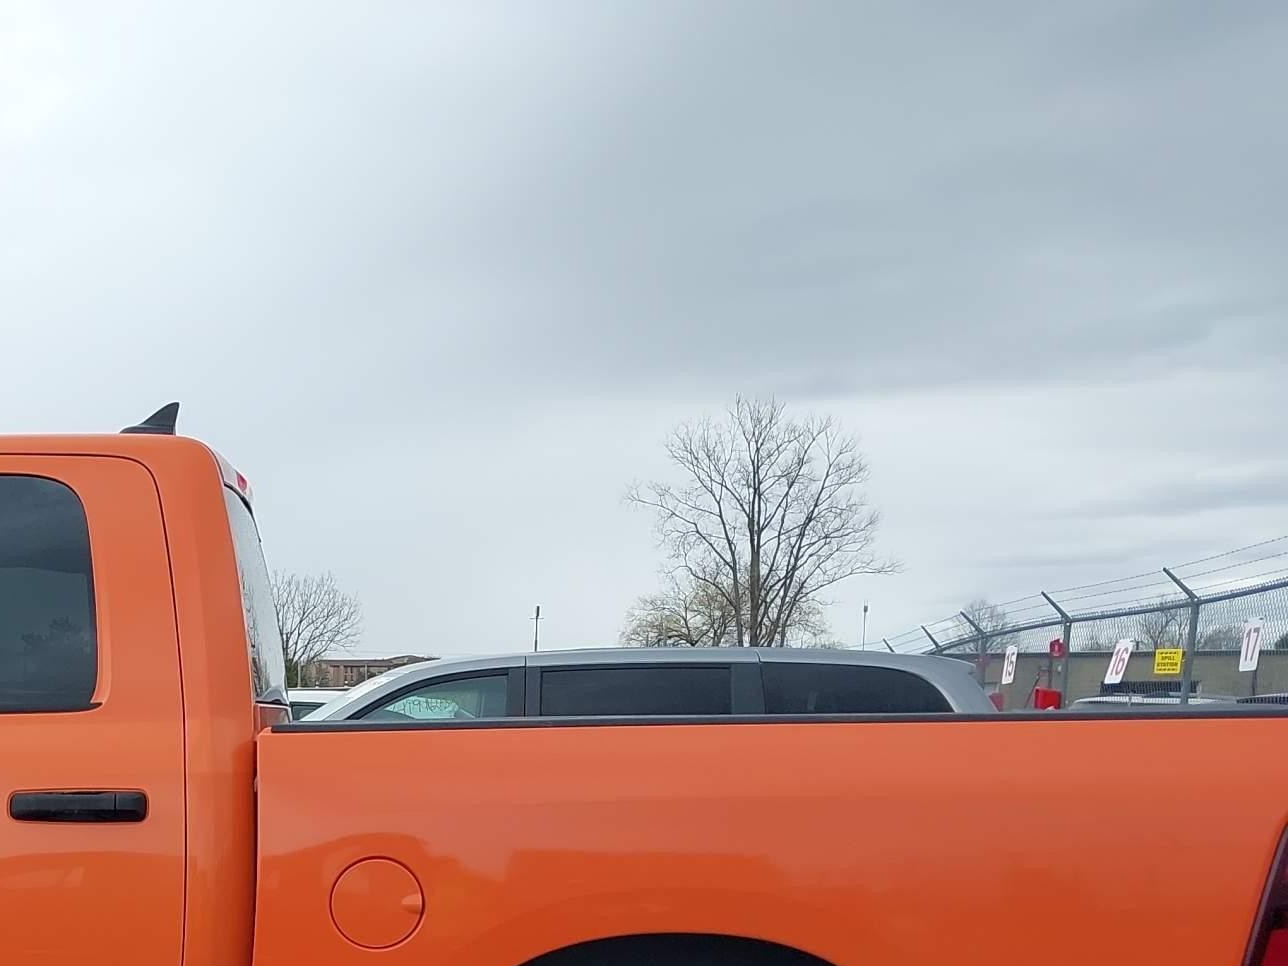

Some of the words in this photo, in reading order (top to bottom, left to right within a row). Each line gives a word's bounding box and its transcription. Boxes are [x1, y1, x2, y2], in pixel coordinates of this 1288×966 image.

[1244, 627, 1262, 661] 17
[1005, 653, 1015, 677] 15
[1109, 646, 1129, 676] 16
